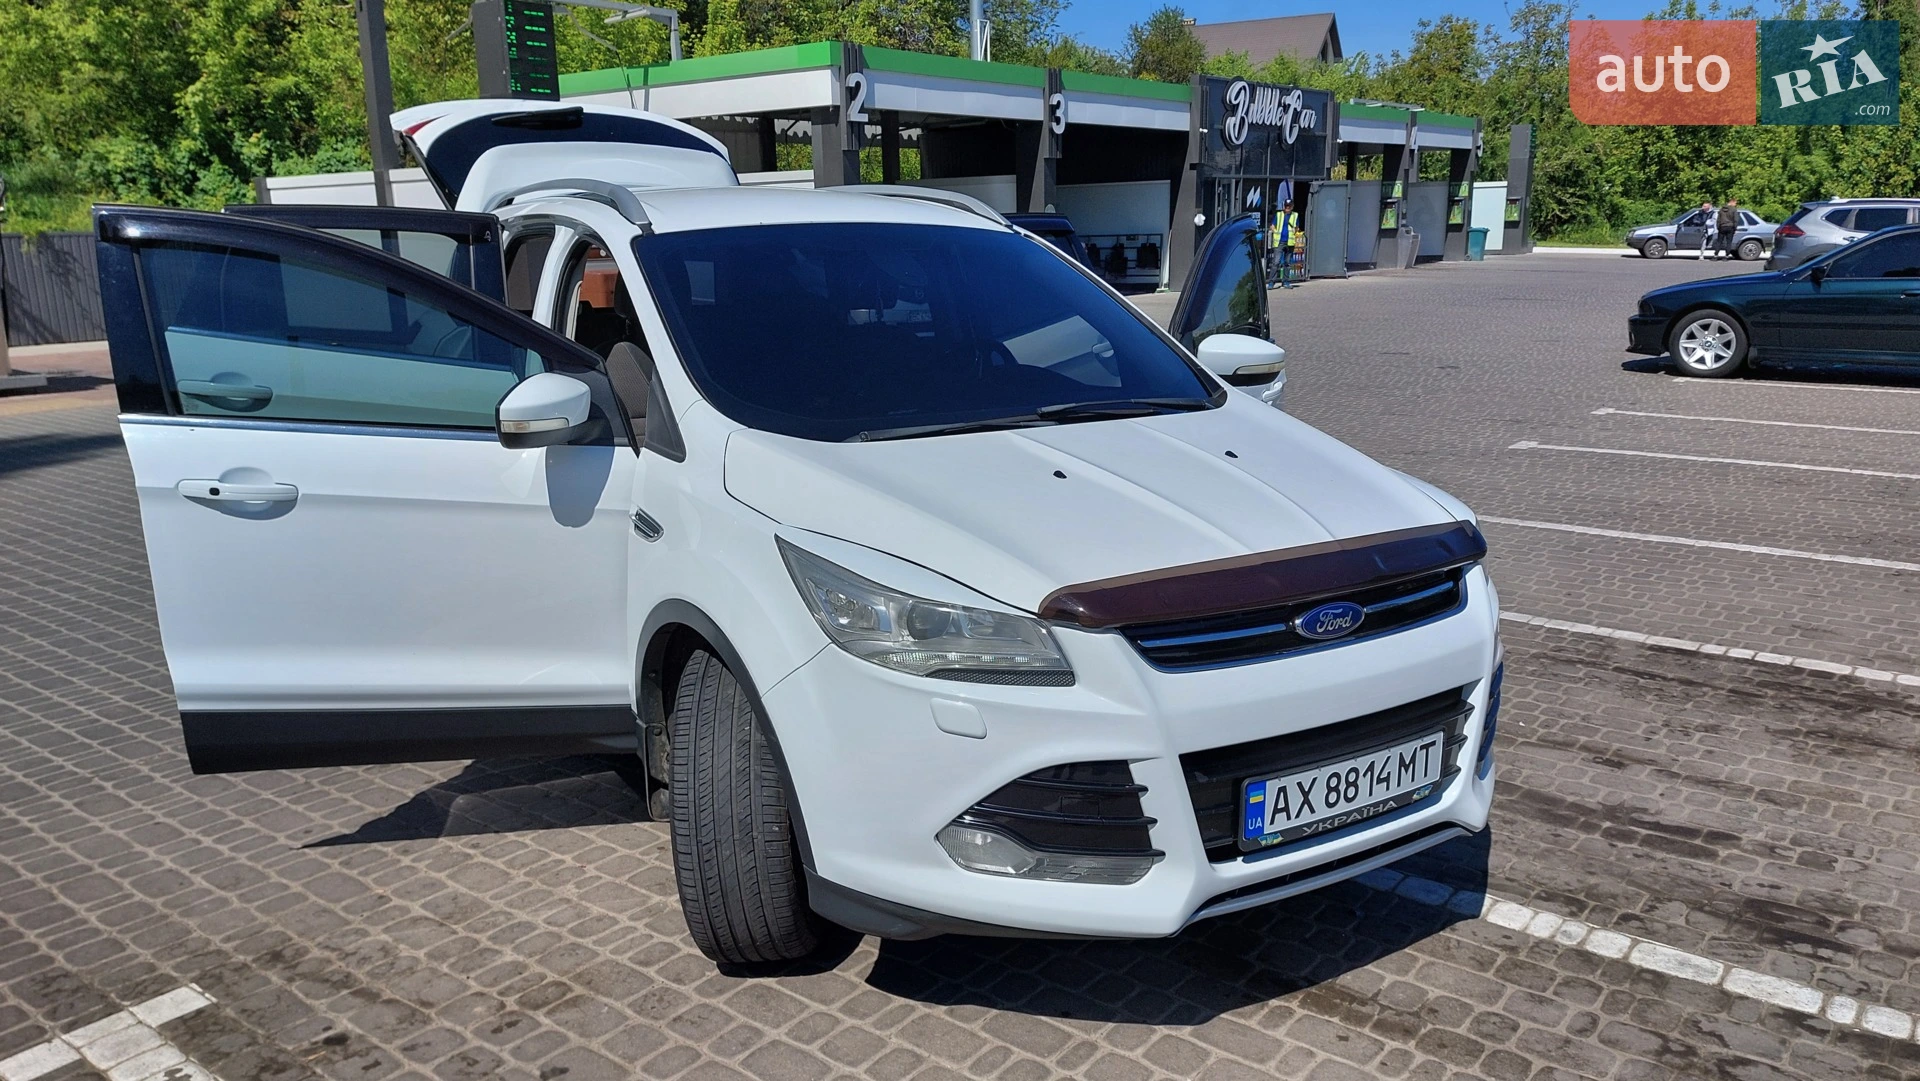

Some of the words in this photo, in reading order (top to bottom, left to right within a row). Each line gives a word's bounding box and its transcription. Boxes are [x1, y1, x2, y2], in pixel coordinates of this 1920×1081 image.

[846, 72, 868, 122] 2
[1050, 93, 1066, 134] 3
[1317, 608, 1352, 632] Ford
[1269, 777, 1318, 825] AX
[1324, 755, 1391, 808] 8814
[1397, 740, 1436, 787] MT
[1248, 818, 1263, 830] UA
[1302, 800, 1398, 836] УКРАЇНА
